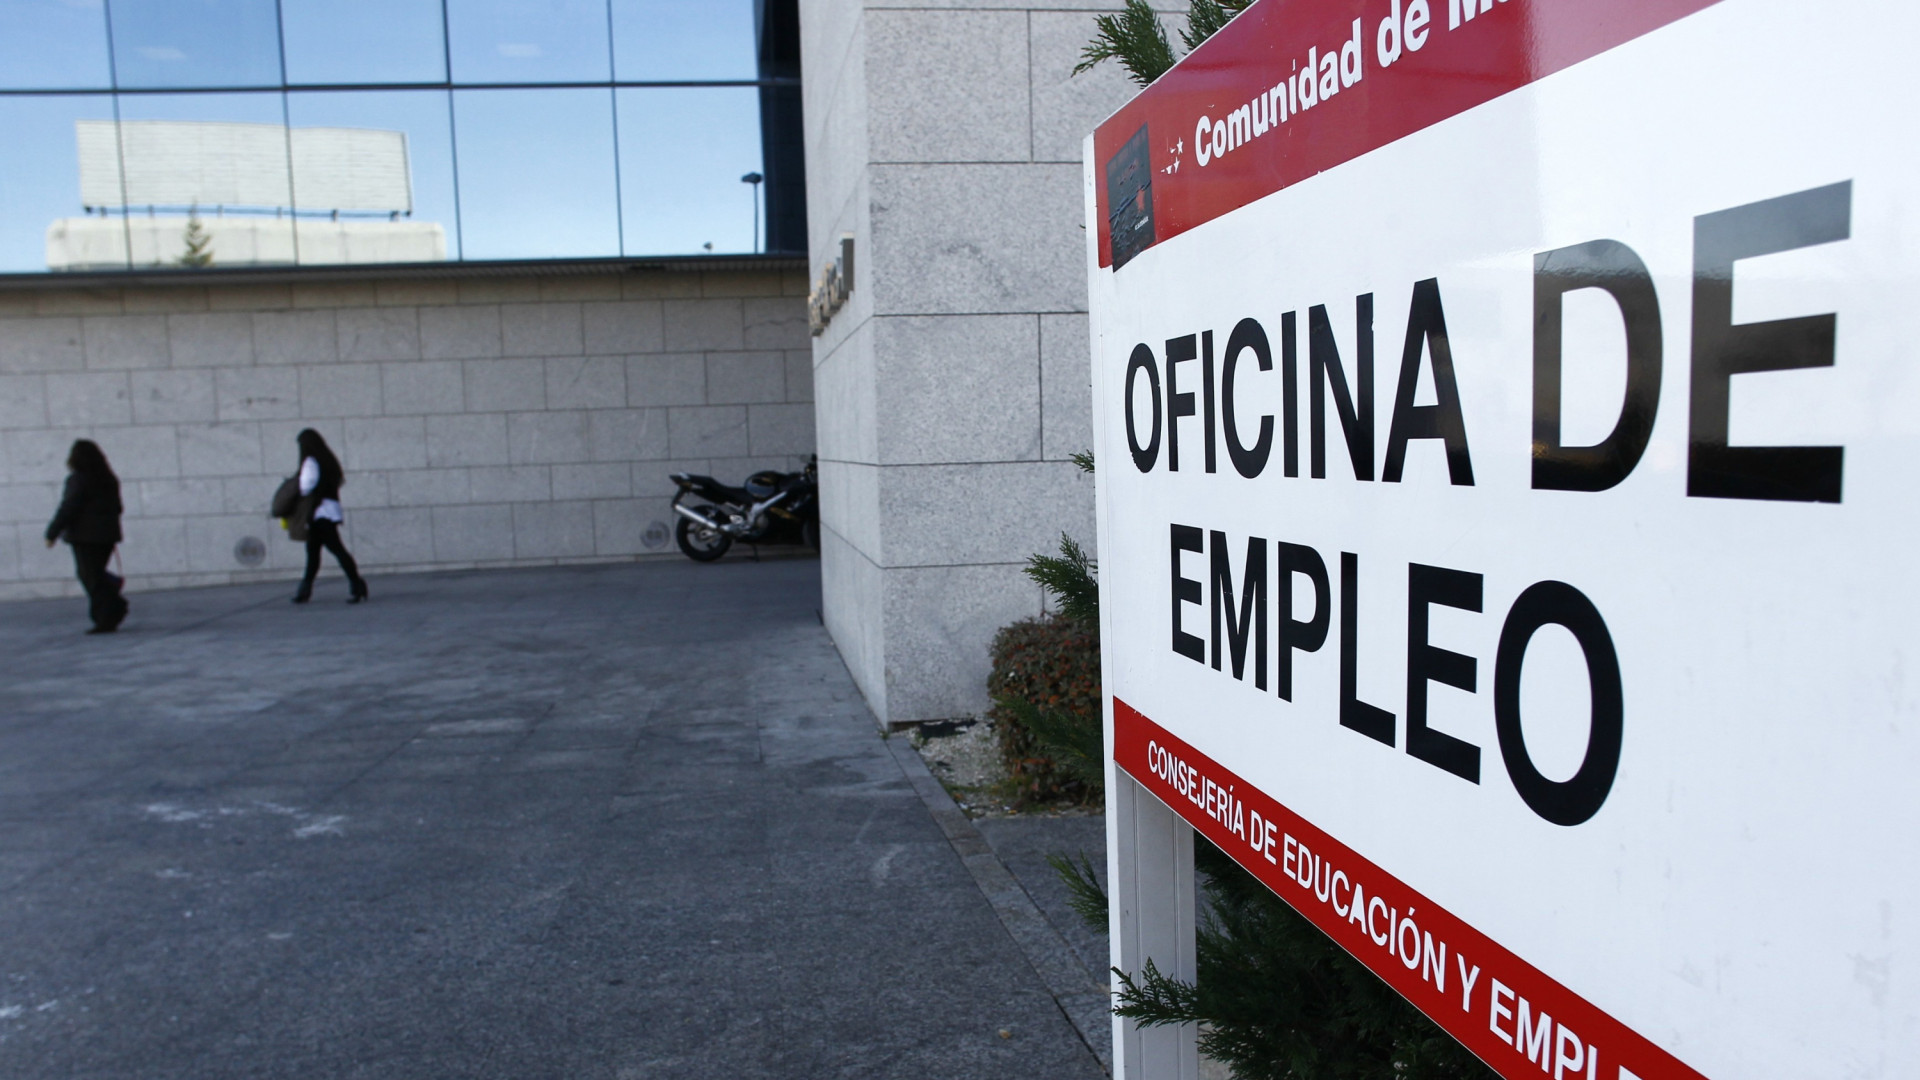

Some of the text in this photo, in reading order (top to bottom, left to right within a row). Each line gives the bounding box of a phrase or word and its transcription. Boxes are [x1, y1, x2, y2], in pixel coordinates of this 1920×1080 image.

[1194, 0, 1430, 167] Comunidad de
[1125, 179, 1853, 504] OFICINA DE
[1170, 523, 1624, 827] EMPLEO
[1148, 740, 1643, 1080] CONSEJERÍA DE EDUCACIÓN Y EMP
